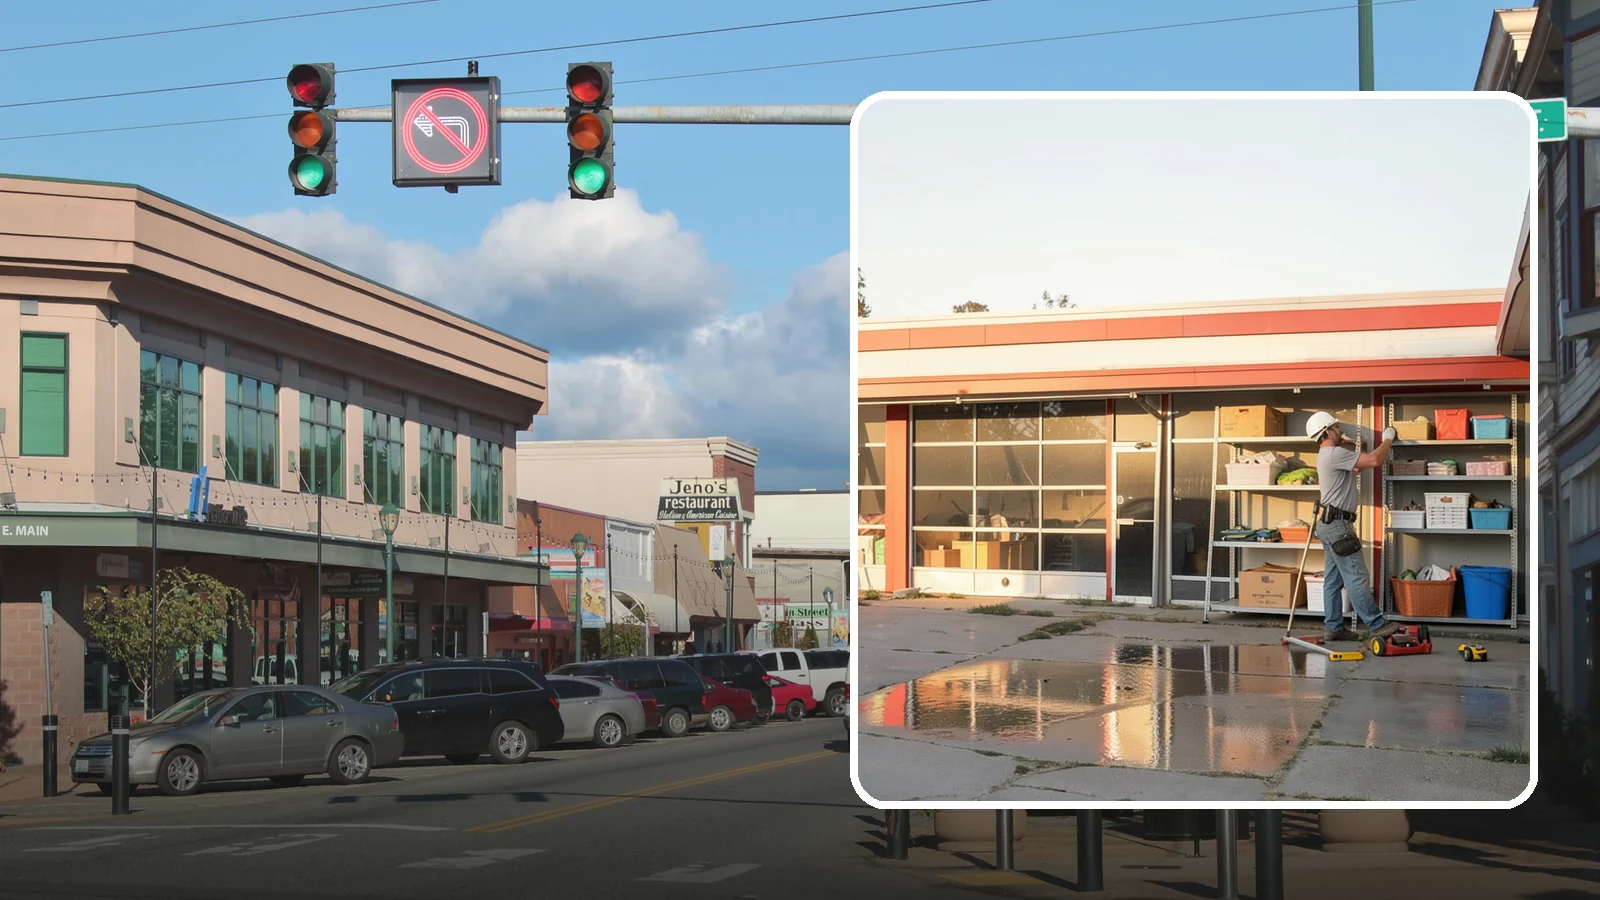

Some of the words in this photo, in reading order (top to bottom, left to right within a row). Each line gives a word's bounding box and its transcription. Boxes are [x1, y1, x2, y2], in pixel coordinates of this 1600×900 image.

[670, 480, 727, 494] Jeno's
[665, 496, 731, 509] restaurant
[685, 509, 714, 519] American
[715, 509, 737, 519] Cuisine
[2, 525, 13, 536] E.
[15, 525, 49, 537] MAIN
[797, 607, 829, 617] Street
